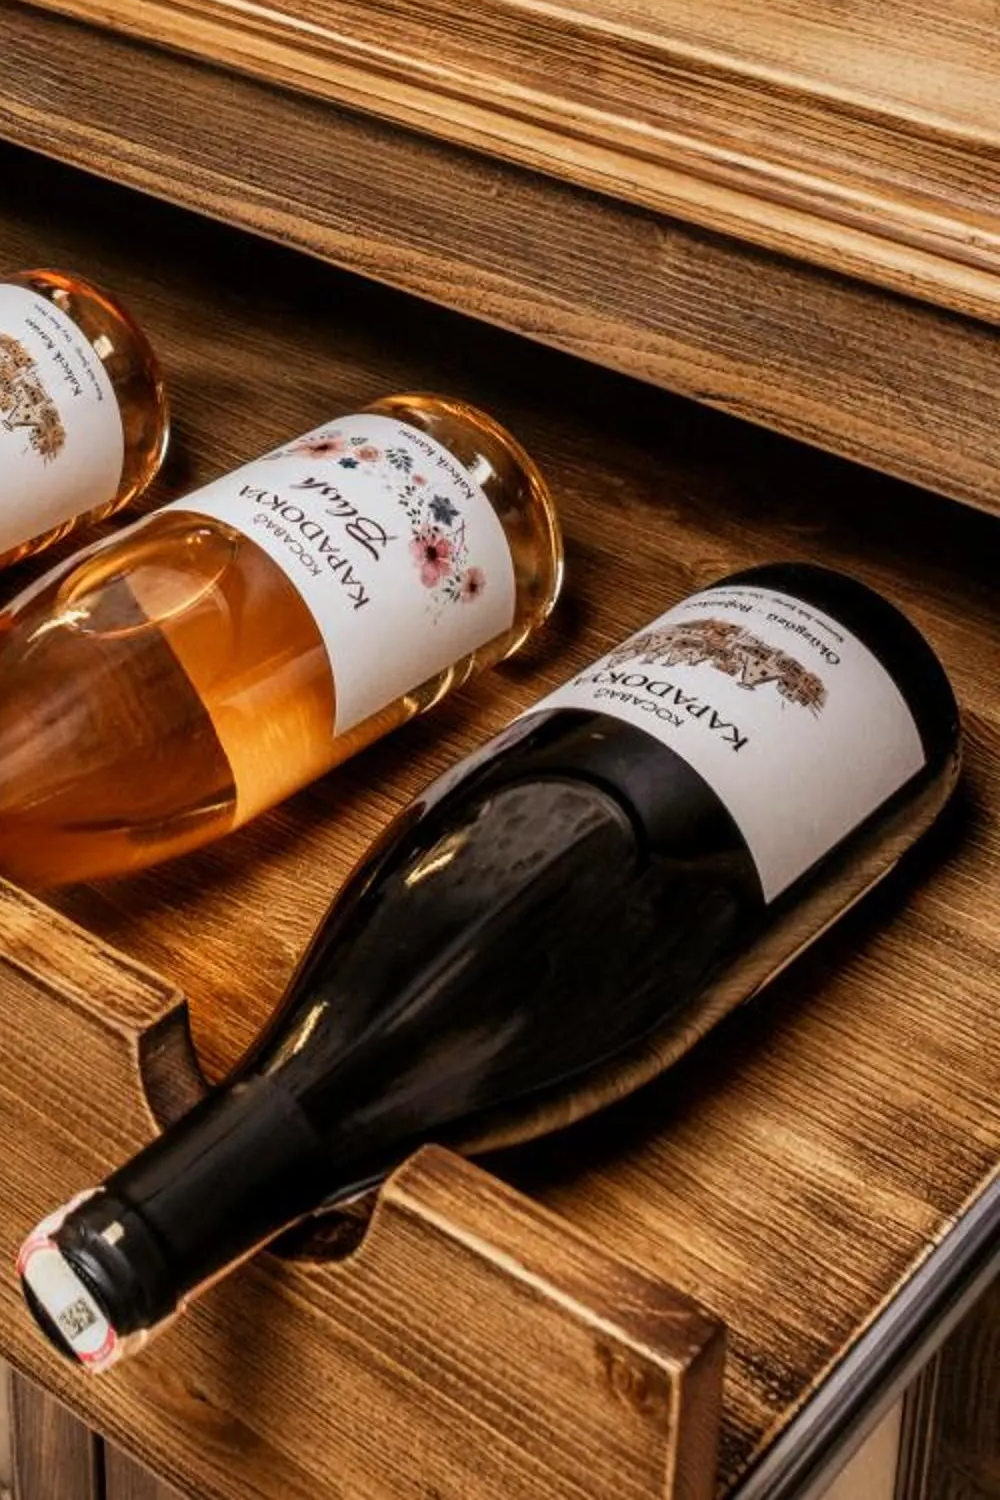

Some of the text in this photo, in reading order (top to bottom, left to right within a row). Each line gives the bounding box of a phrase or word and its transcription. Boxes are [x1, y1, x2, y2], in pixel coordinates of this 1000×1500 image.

[436, 455, 476, 501] Kalecik
[238, 485, 371, 610] KAPADOKYA
[253, 512, 323, 577] KOCABAĞ
[290, 476, 398, 562] Blush
[593, 686, 685, 728] KOCABAĞ
